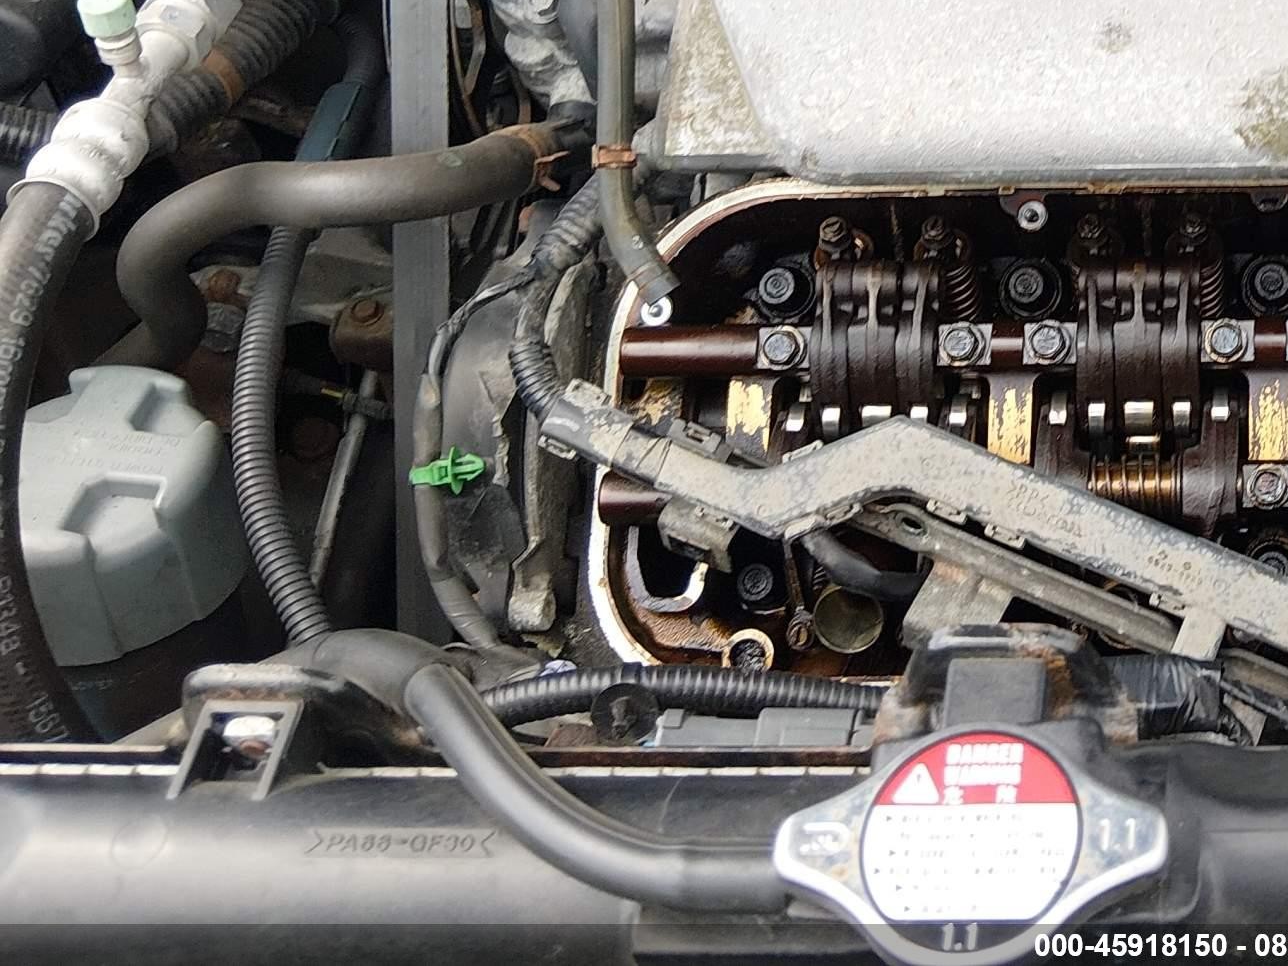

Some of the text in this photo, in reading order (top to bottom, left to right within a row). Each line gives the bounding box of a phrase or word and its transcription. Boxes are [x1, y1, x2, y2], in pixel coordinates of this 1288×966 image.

[946, 742, 1024, 765] DANGER
[1098, 818, 1137, 851] 1.1
[941, 922, 979, 951] 1.1
